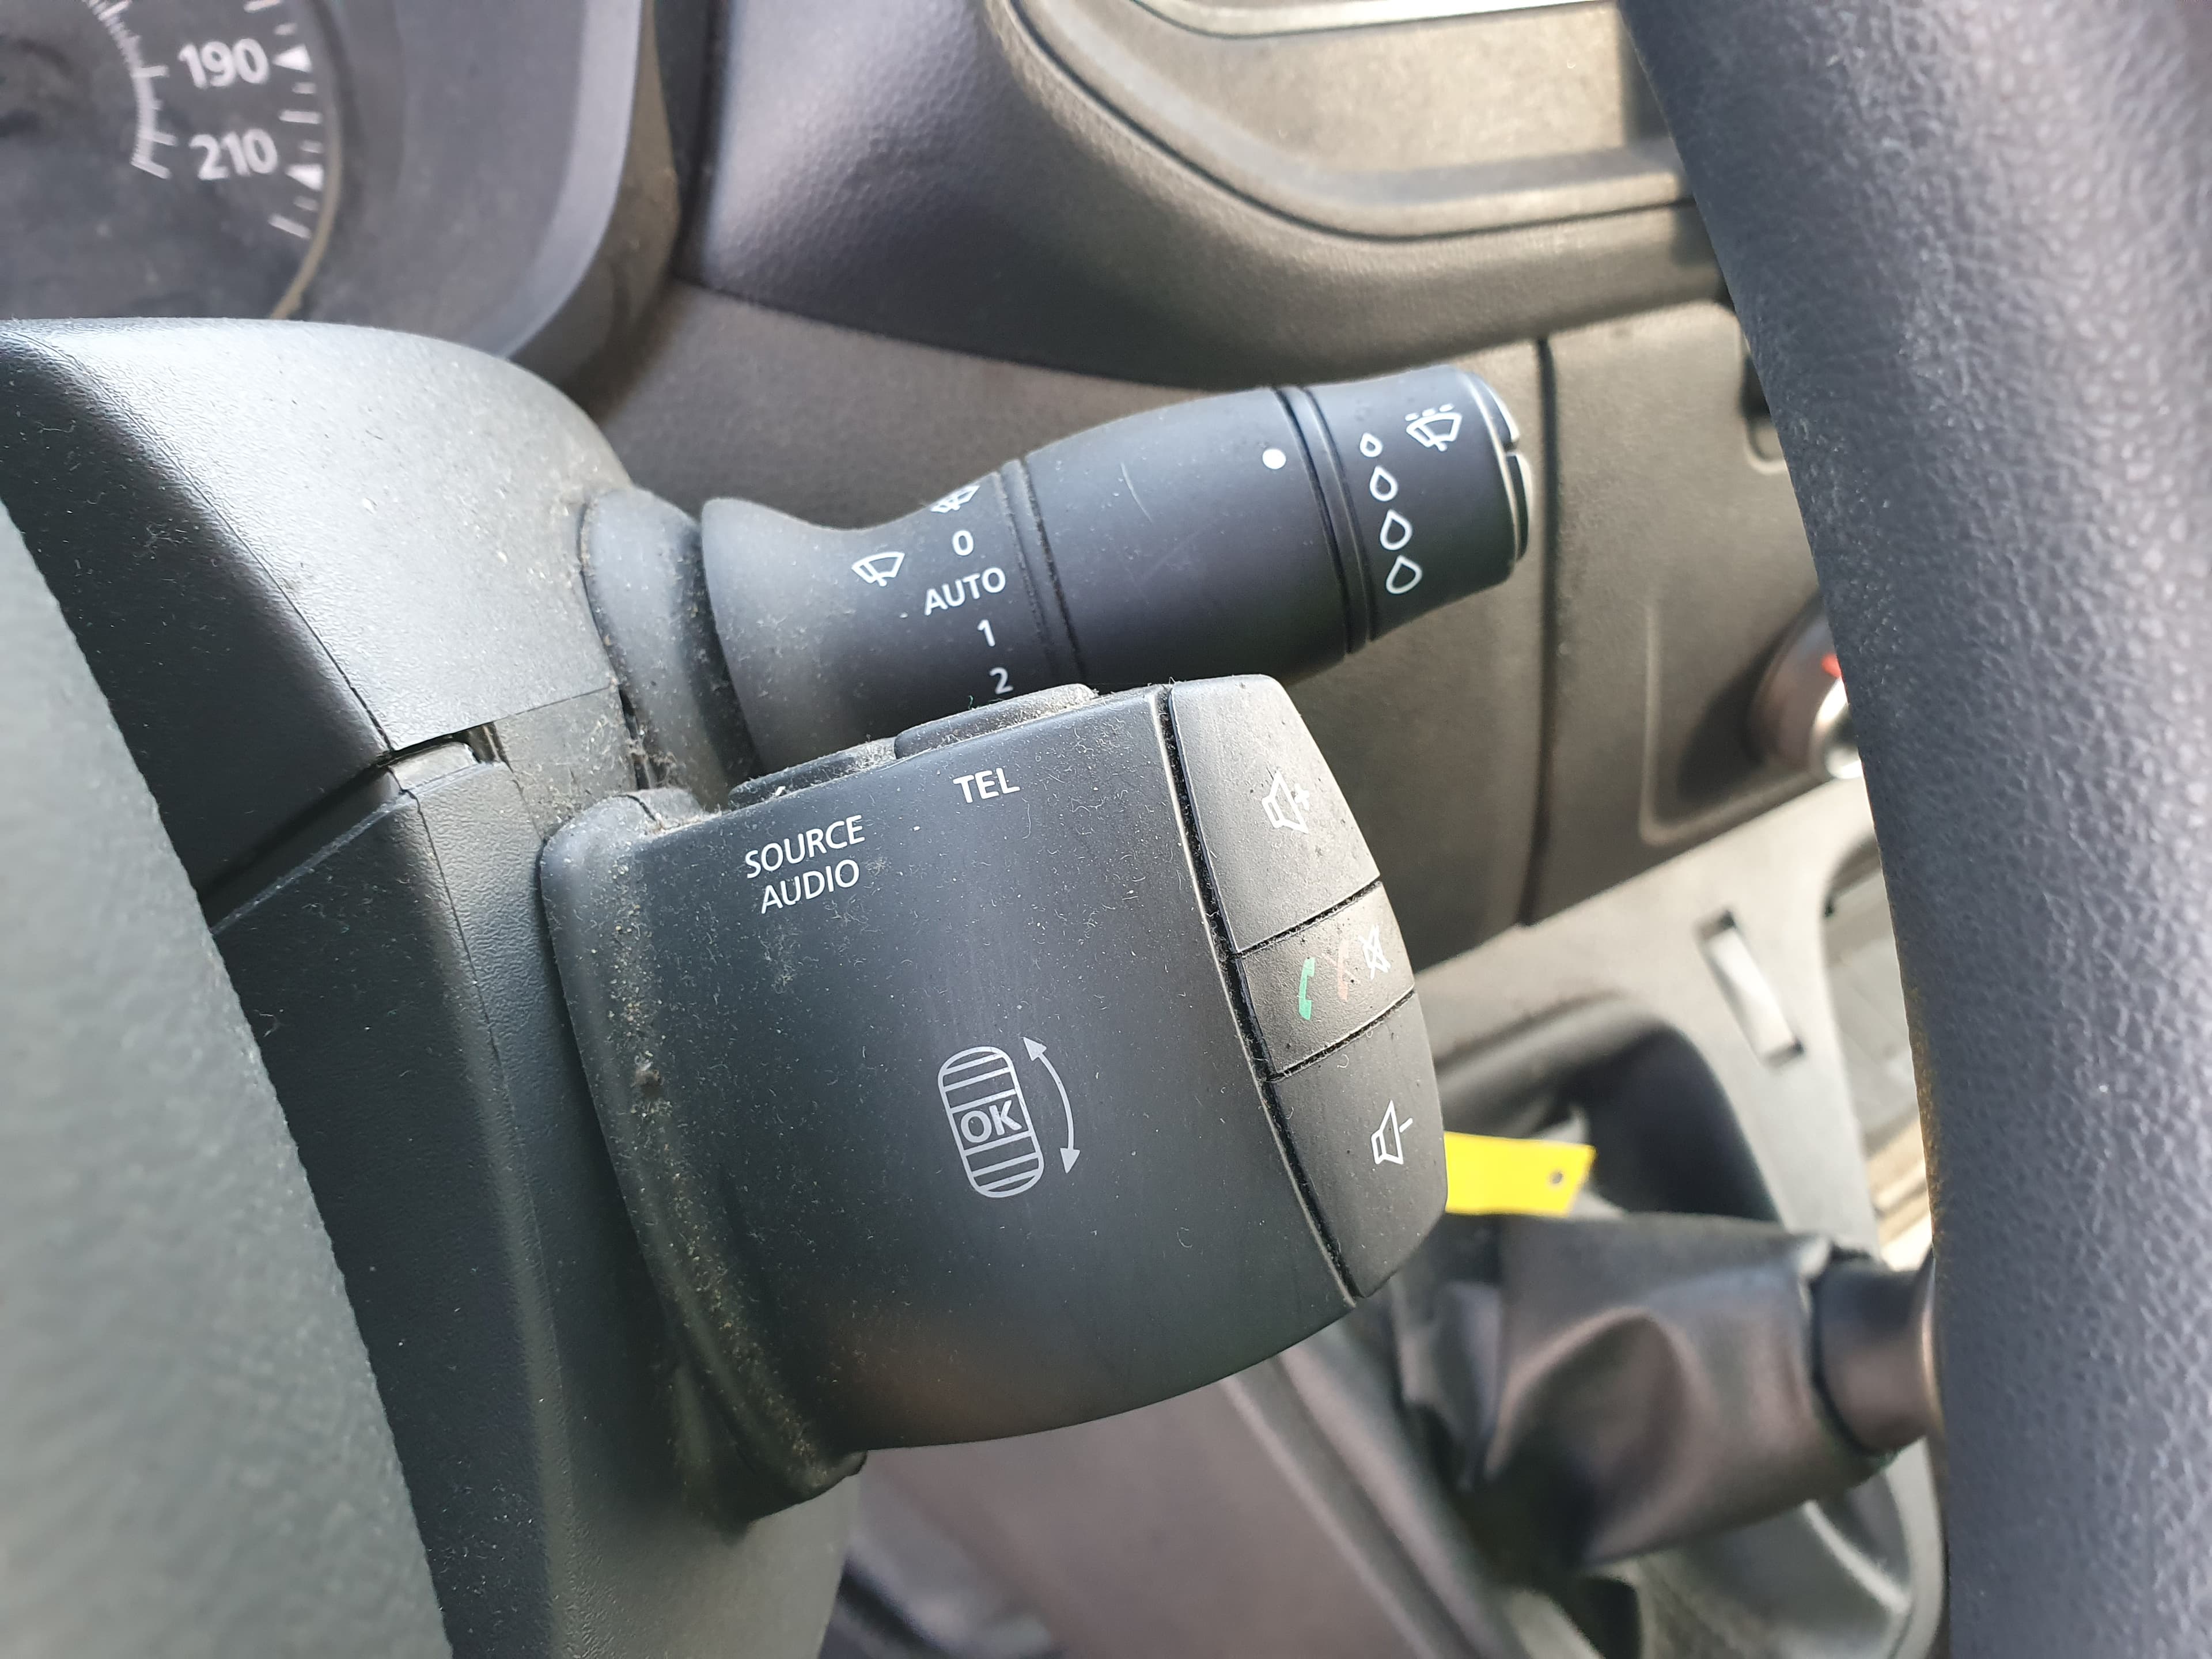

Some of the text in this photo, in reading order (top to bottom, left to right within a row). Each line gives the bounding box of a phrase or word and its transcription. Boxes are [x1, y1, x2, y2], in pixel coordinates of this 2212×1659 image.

[178, 37, 270, 88] 190
[190, 128, 278, 181] 210
[952, 529, 974, 556] 0
[925, 567, 1006, 616] AUTO
[978, 619, 995, 647] 1
[989, 667, 1013, 694] 2
[953, 767, 1021, 803] TEL
[744, 814, 865, 878] SOURCE
[760, 859, 860, 914] AUDIO
[960, 1100, 1022, 1143] OK
